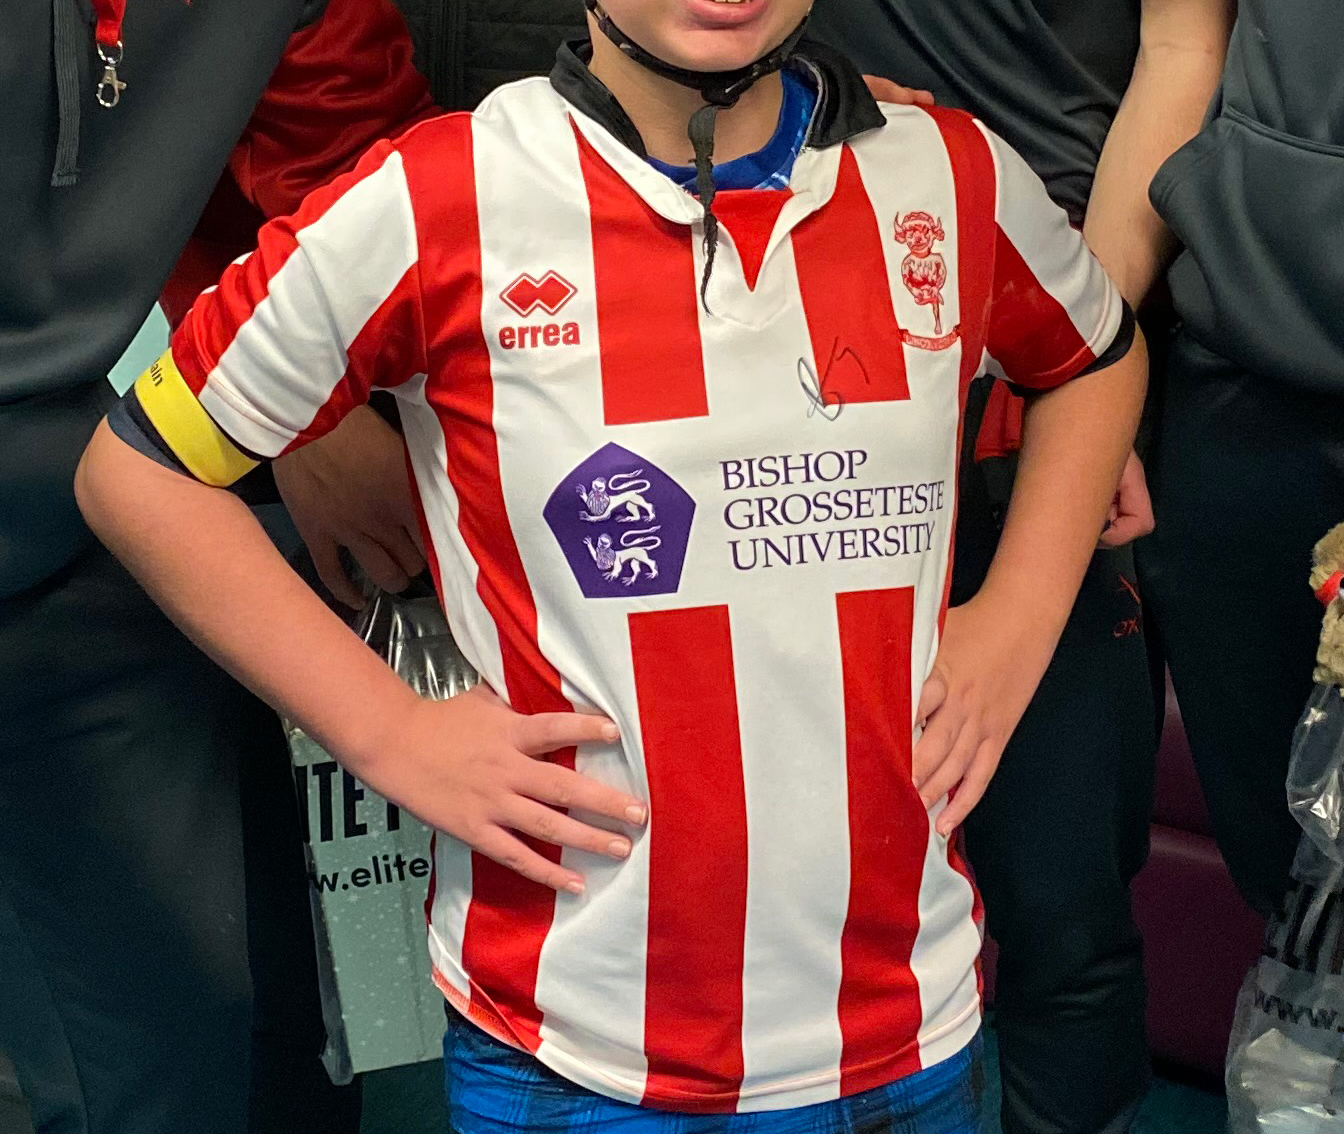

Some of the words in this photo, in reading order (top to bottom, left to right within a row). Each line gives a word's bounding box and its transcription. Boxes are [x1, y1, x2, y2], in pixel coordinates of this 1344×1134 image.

[499, 322, 581, 350] errea
[719, 449, 868, 491] BISHOP
[723, 480, 945, 530] GROSSETESTE
[727, 520, 936, 570] UNIVERSITY
